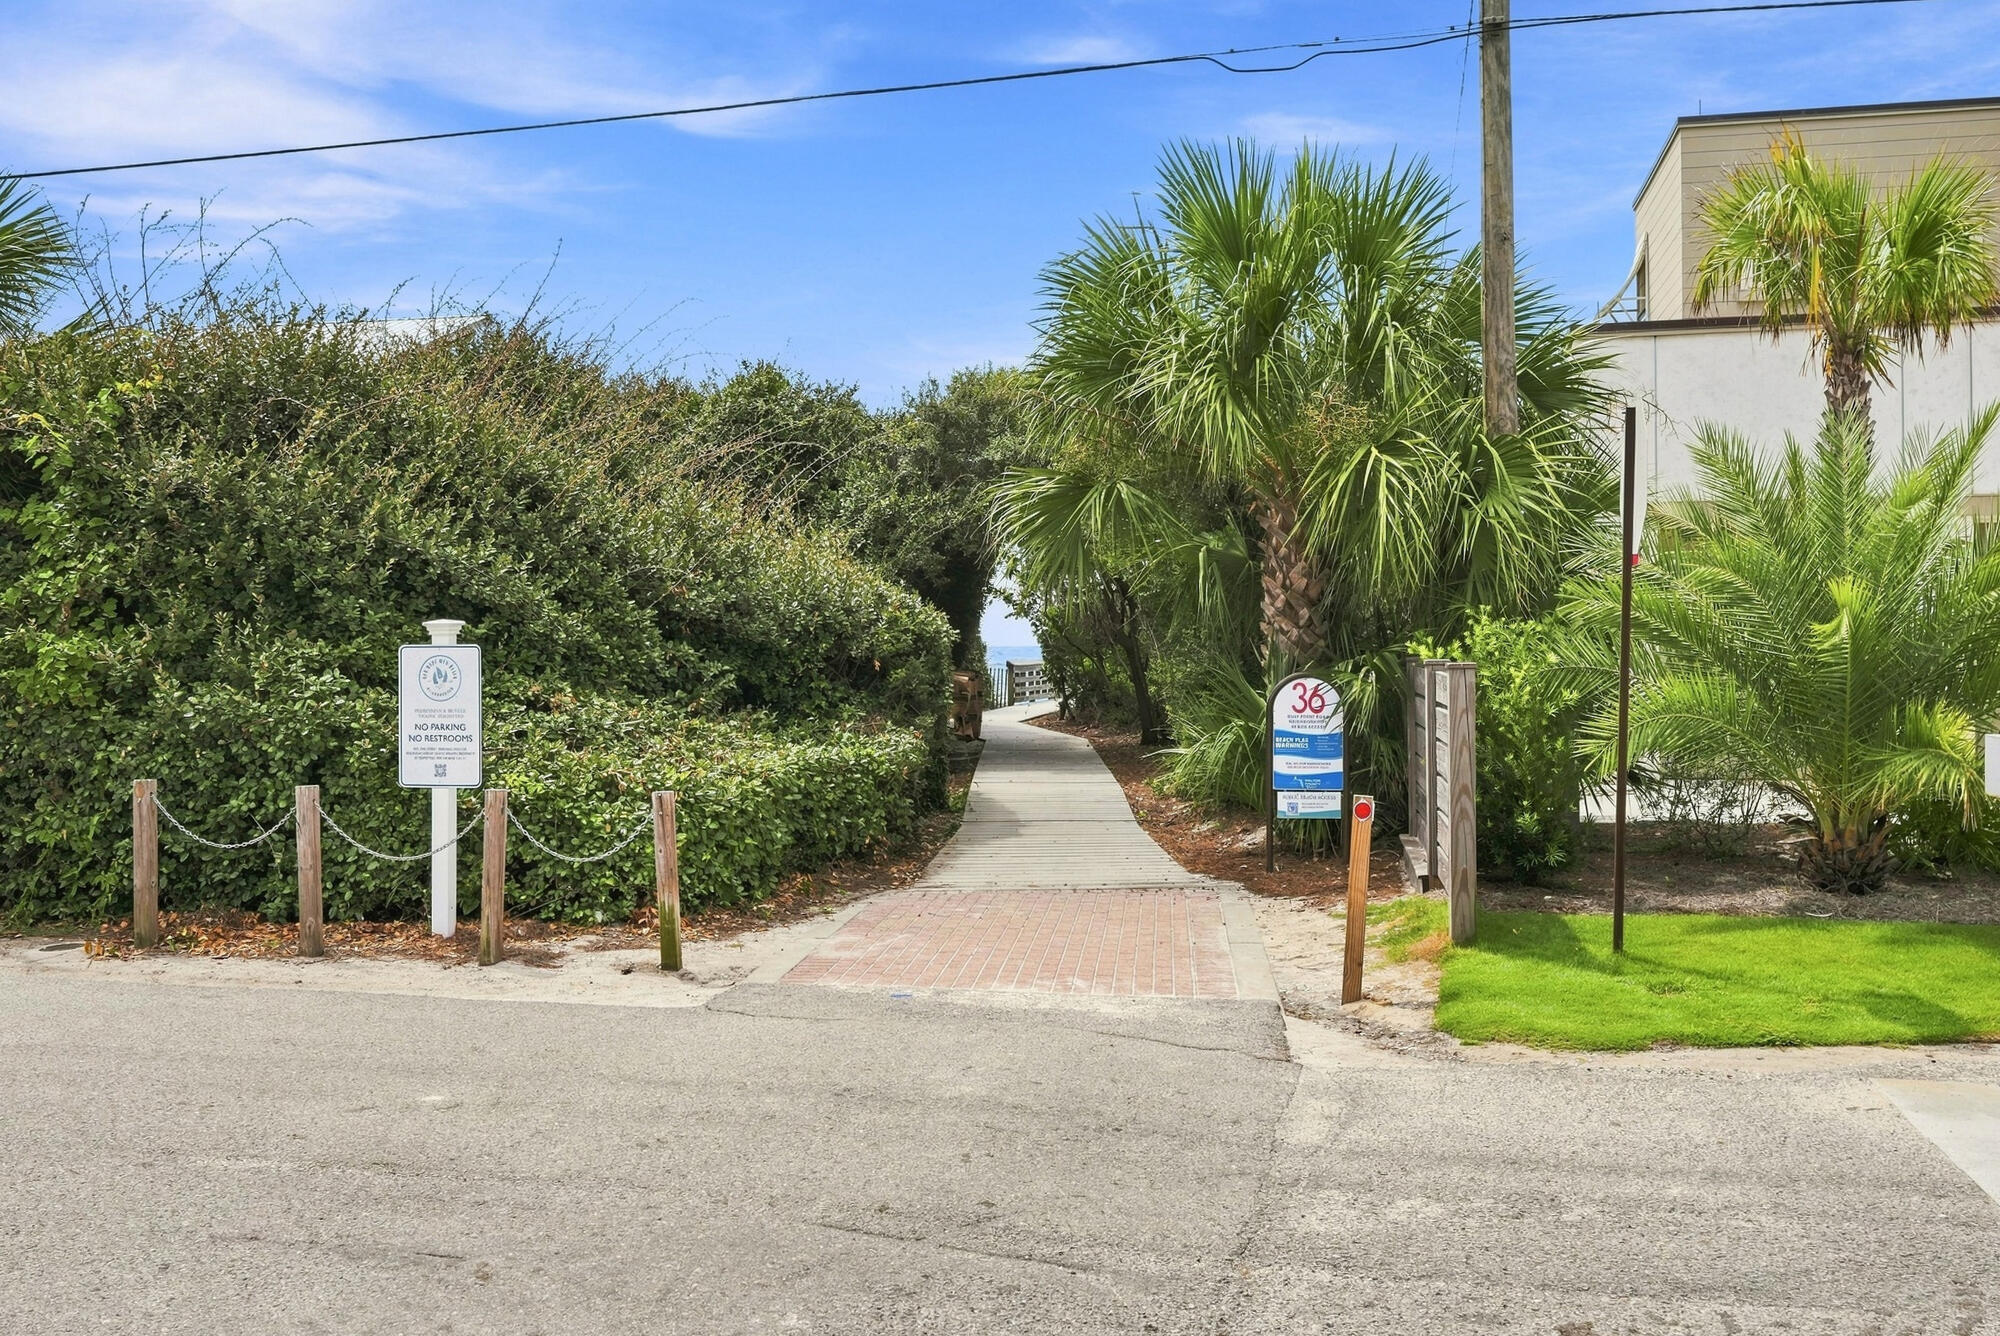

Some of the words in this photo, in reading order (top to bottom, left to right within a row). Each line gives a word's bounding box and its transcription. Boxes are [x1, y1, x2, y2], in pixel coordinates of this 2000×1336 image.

[1292, 682, 1325, 714] 36
[414, 723, 429, 732] NO
[430, 723, 466, 732] PARKING
[408, 734, 423, 743] NO
[424, 734, 473, 743] RESTROOMS
